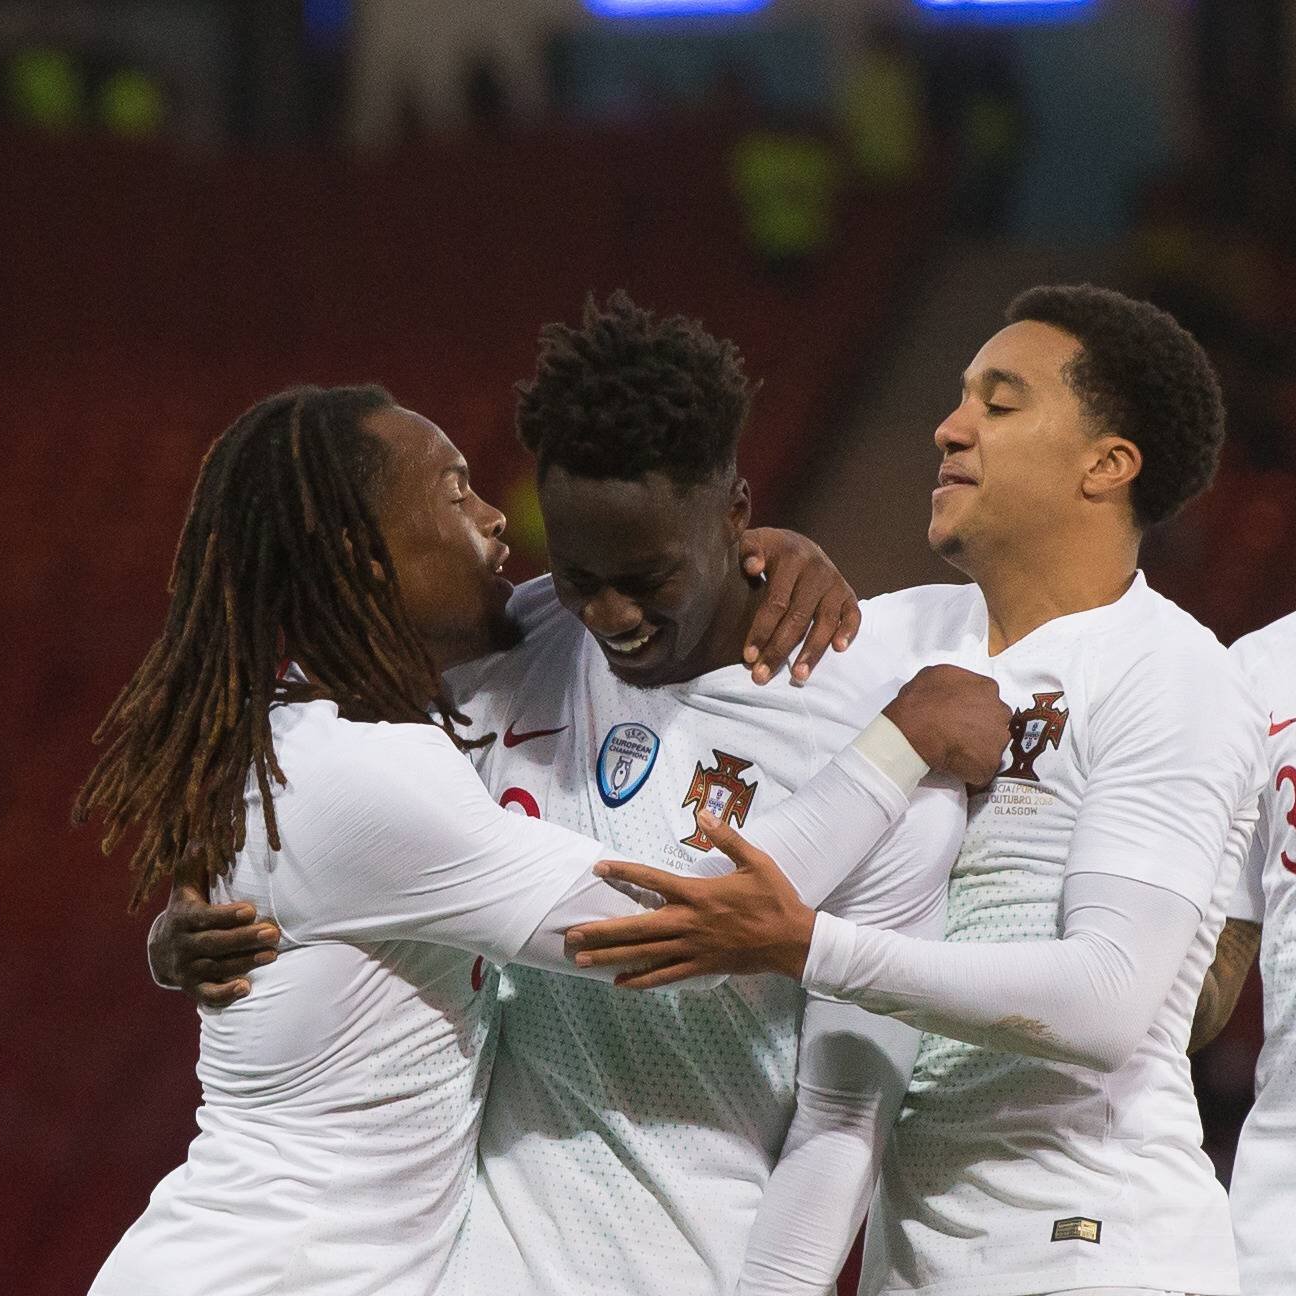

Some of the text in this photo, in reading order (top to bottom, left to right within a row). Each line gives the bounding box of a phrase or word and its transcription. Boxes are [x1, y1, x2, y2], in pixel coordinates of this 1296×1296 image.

[611, 736, 653, 754] EUROPEAN
[609, 744, 648, 761] CHAMPIONS
[990, 795, 1032, 805] OUTUBRO
[994, 806, 1037, 816] GLASGOW
